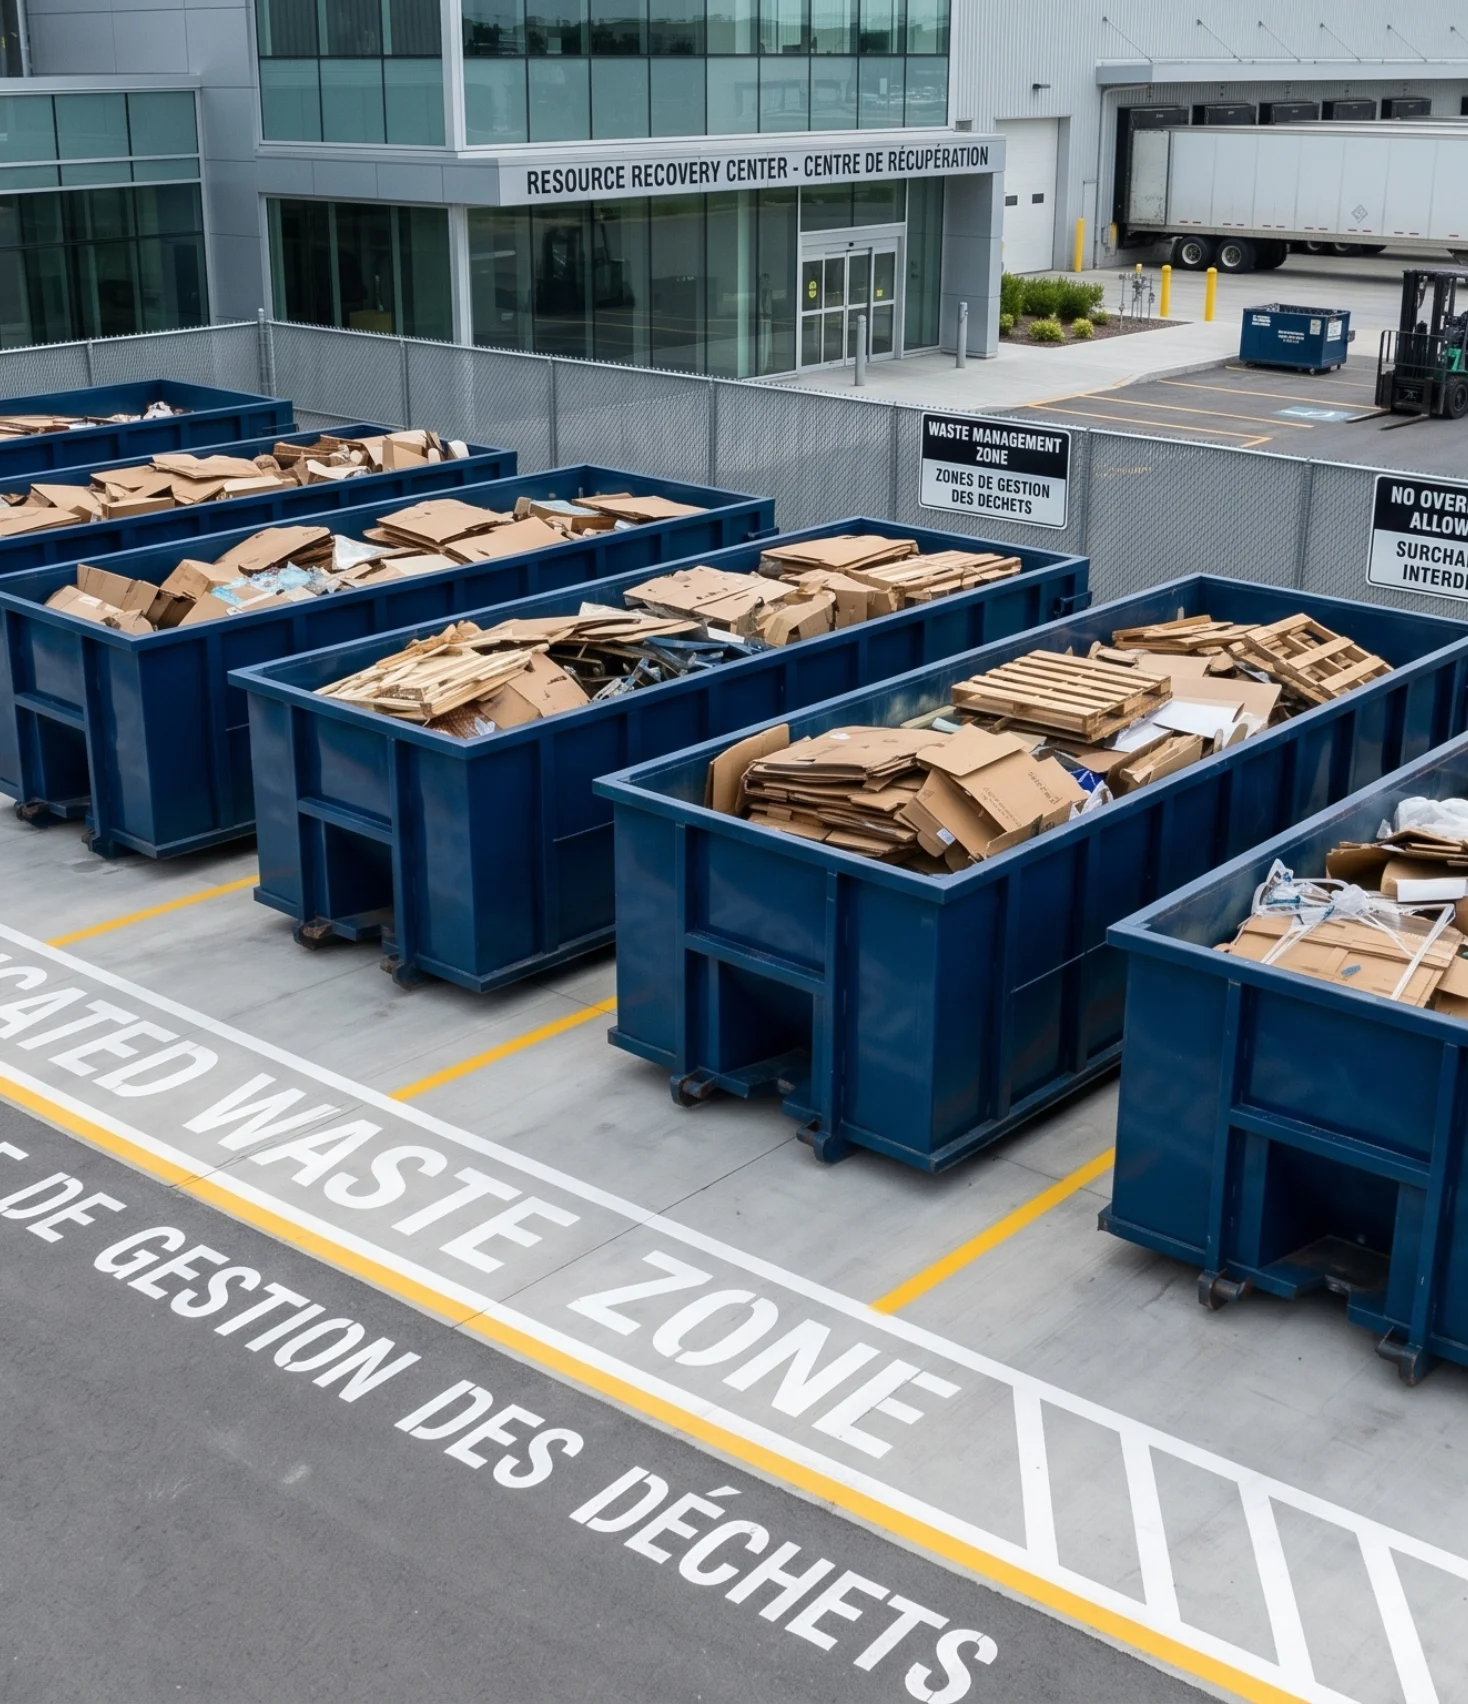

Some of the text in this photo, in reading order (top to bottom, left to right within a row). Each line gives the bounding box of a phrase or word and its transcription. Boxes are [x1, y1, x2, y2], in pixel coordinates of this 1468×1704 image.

[527, 166, 625, 195] RESOURCE
[631, 160, 721, 188] RECOVERY
[726, 156, 788, 182] CENTER
[804, 153, 861, 177] CENTRE
[865, 151, 883, 173] DE
[888, 143, 989, 172] RÉCUPÉRATION
[928, 421, 1062, 454] WASTE MANAGEMENT
[976, 446, 1009, 465] ZONE
[936, 468, 1051, 498] ZONES DE GESTION
[952, 489, 1032, 514] DES DECHETS
[1391, 485, 1468, 514] NO OVER
[1409, 511, 1468, 537] ALLOW
[1396, 540, 1468, 568] SURCHA
[182, 1073, 581, 1273] WASTE
[566, 1250, 962, 1460] ZONE
[0, 1171, 999, 1704] DE GESTION DES DÉCHETS
